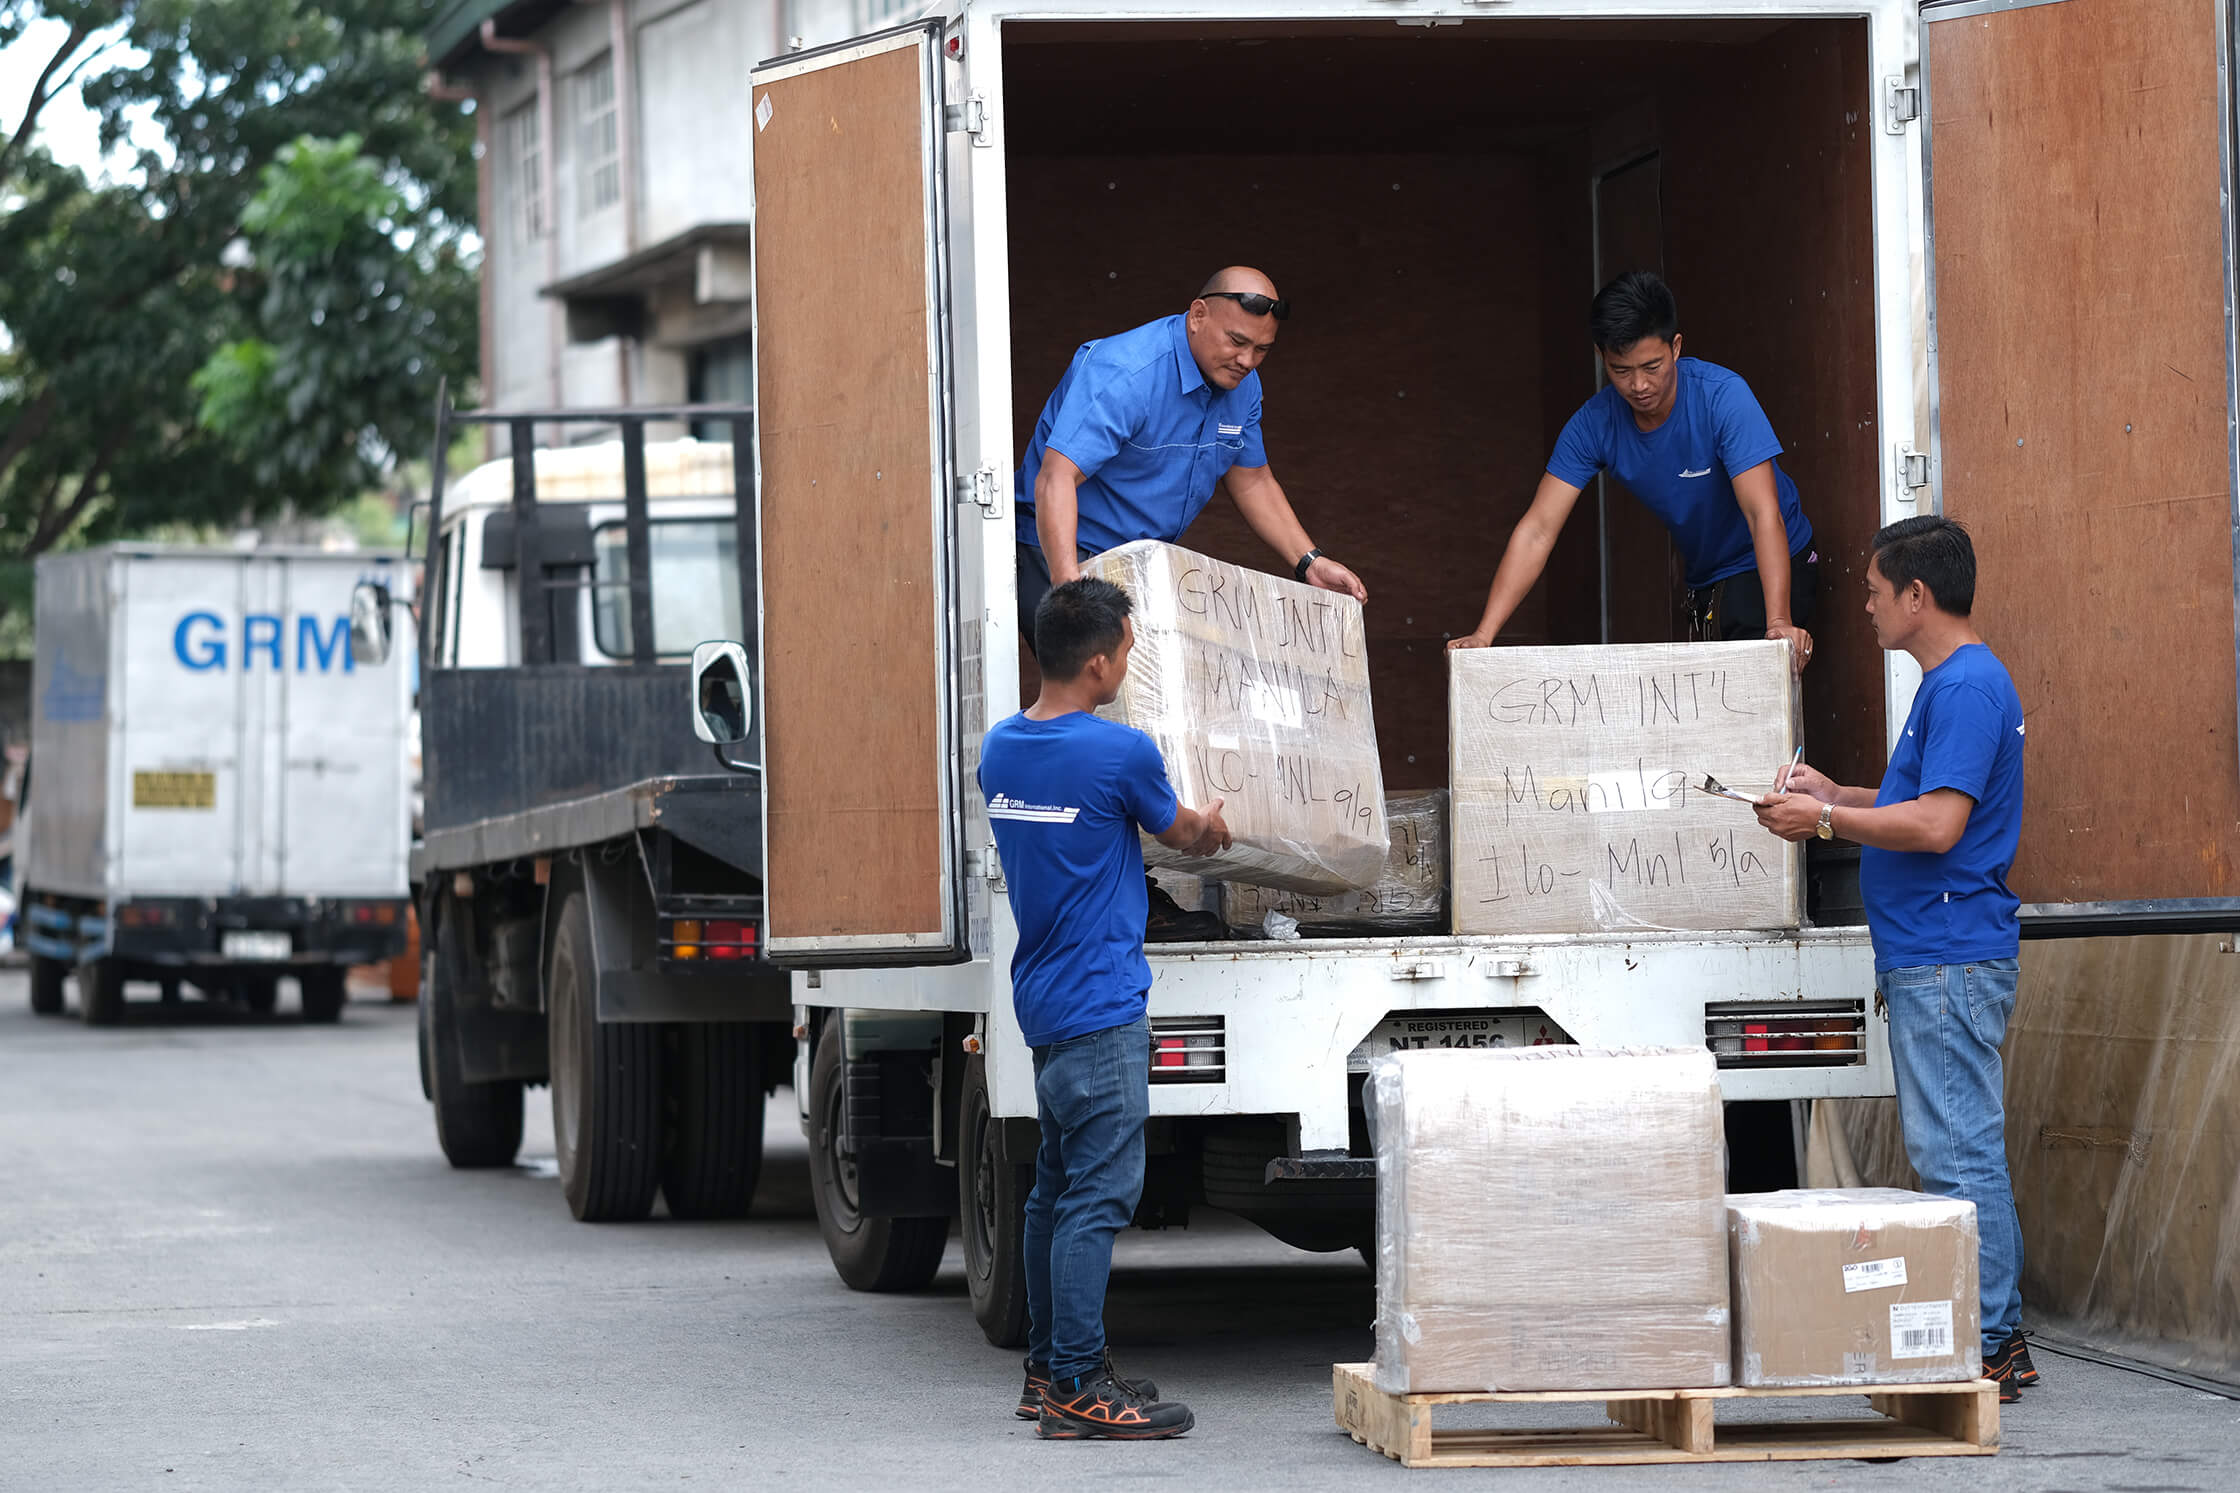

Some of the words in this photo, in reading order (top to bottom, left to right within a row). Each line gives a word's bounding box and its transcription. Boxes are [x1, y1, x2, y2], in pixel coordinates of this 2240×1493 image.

[173, 610, 355, 676] GRM
[1200, 644, 1347, 720] MANILA
[1488, 674, 1605, 727] GRM
[1640, 671, 1758, 727] INT'L
[1009, 799, 1025, 809] GRM
[1334, 782, 1373, 836] 9/9
[1504, 758, 1688, 826] Manila
[1358, 887, 1415, 913] GR
[1408, 1020, 1489, 1033] REGISTERED
